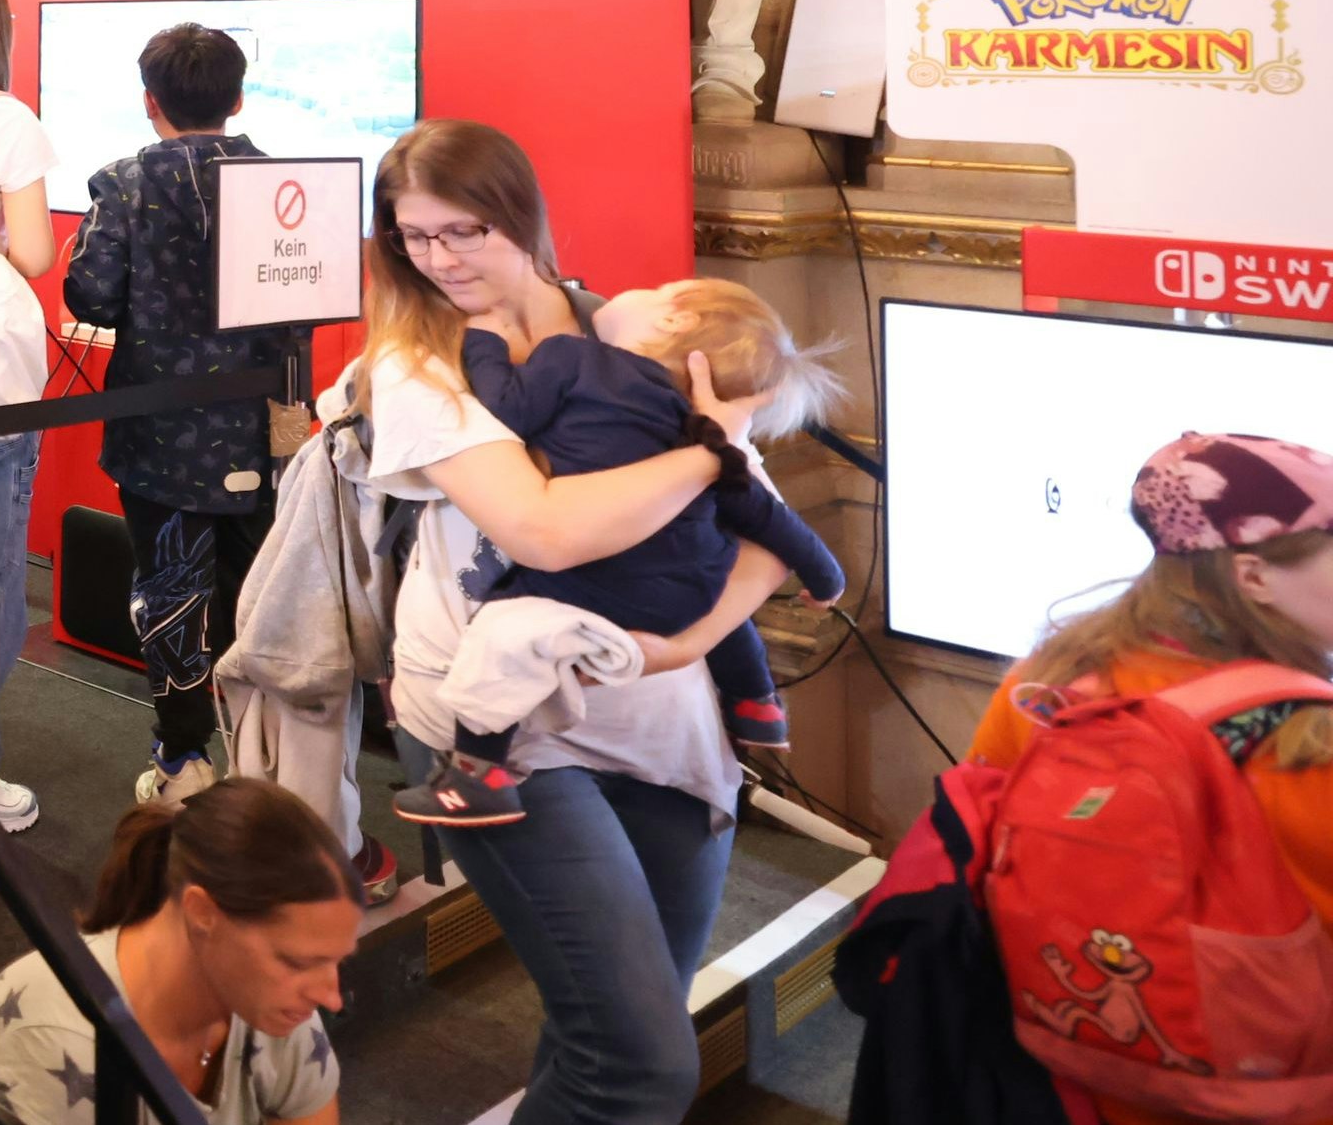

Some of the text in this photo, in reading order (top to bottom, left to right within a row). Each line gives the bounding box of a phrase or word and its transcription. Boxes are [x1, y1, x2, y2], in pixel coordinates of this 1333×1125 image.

[945, 29, 1252, 73] KARMESIN
[273, 238, 307, 258] Kein
[257, 261, 322, 286] Eingang!
